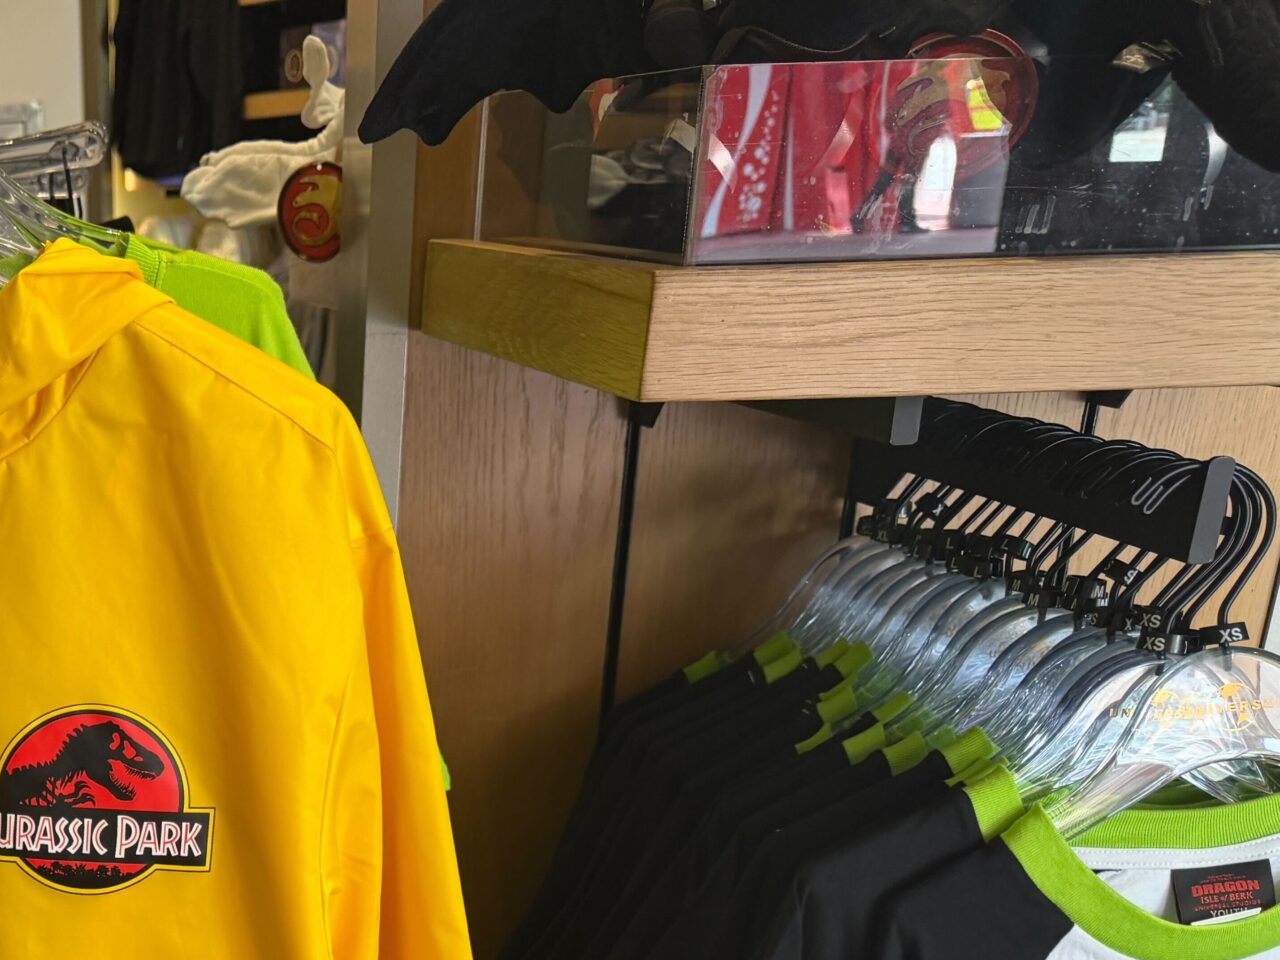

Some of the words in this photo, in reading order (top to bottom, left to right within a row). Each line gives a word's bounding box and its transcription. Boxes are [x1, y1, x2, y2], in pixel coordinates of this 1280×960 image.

[1028, 593, 1040, 607] M
[1140, 612, 1162, 629] XS
[1219, 627, 1243, 643] XS
[1143, 636, 1166, 651] XS
[114, 814, 202, 859] PARK
[1191, 879, 1260, 898] DRAGON
[1201, 895, 1219, 904] ISLE
[1220, 894, 1228, 902] of
[1229, 891, 1254, 901] BERK
